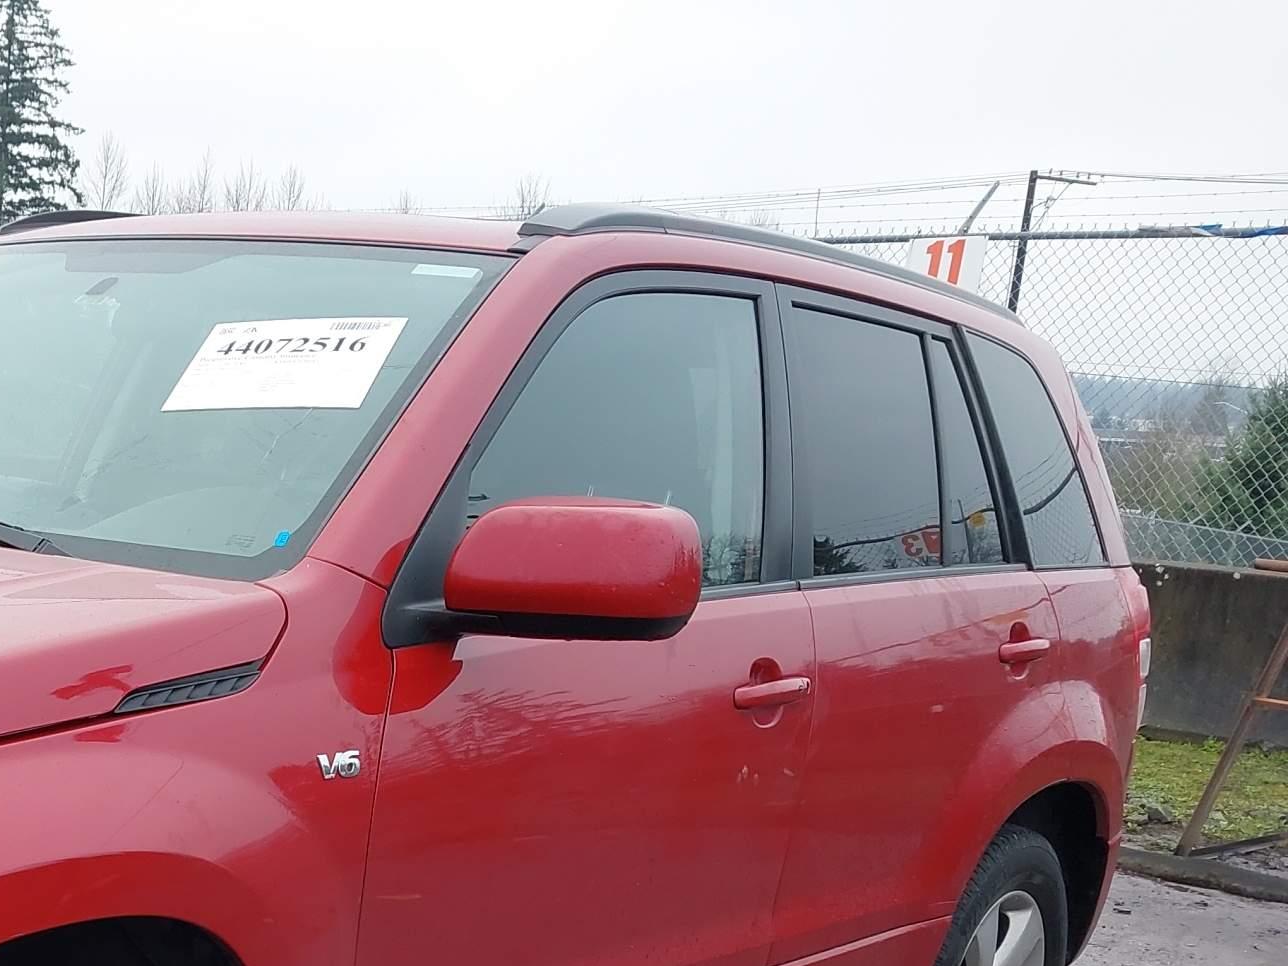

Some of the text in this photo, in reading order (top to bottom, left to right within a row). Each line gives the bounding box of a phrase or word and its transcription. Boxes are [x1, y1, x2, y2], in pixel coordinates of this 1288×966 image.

[925, 238, 967, 286] 11
[216, 335, 370, 355] 44072516
[316, 749, 361, 779] V6
